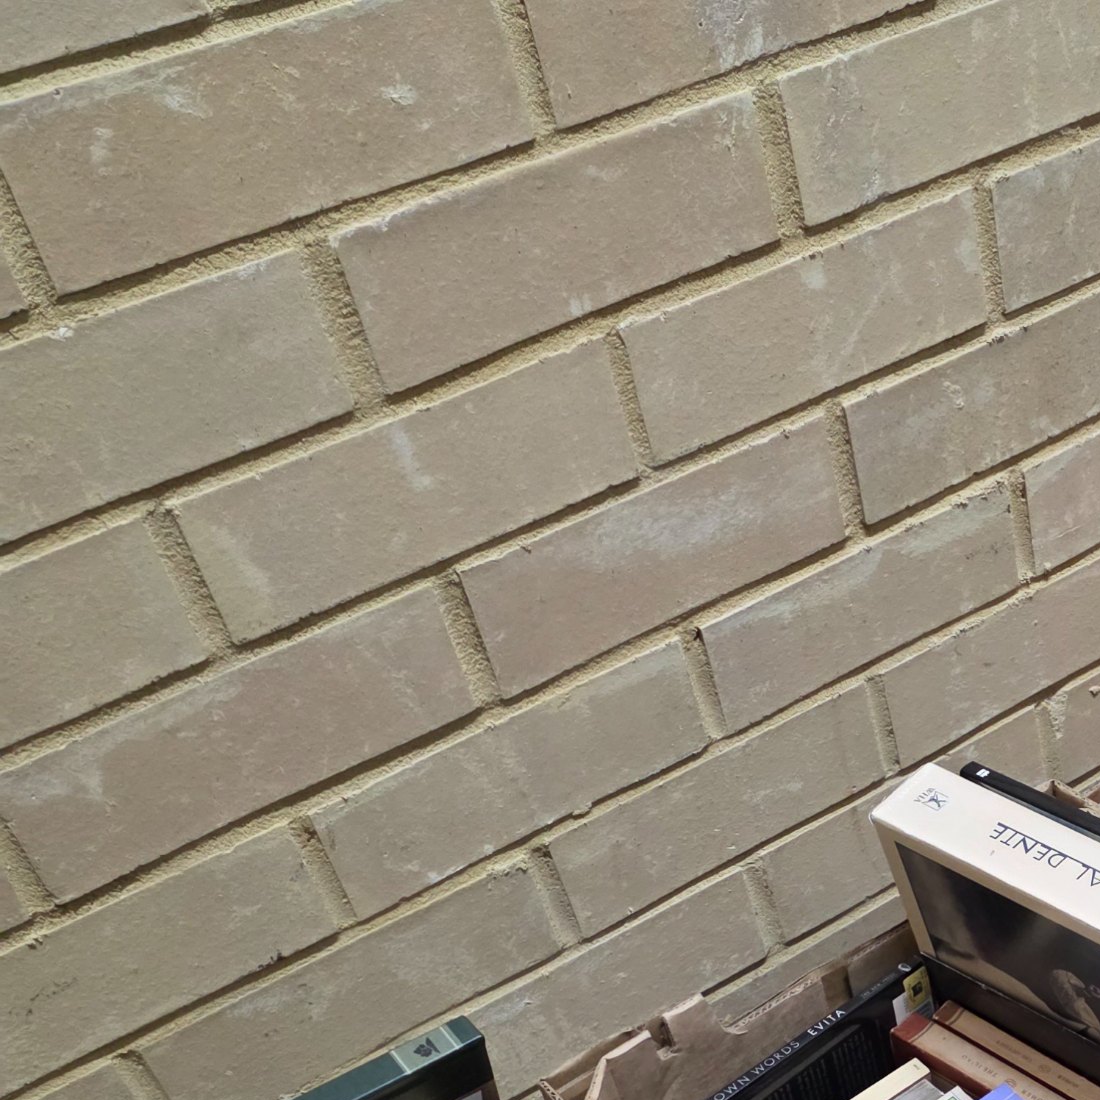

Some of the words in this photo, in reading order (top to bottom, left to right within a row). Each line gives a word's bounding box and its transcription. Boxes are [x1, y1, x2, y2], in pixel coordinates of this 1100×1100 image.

[988, 821, 1070, 869] DENTE
[750, 1039, 801, 1078] WORDS
[806, 1008, 847, 1037] EVITA
